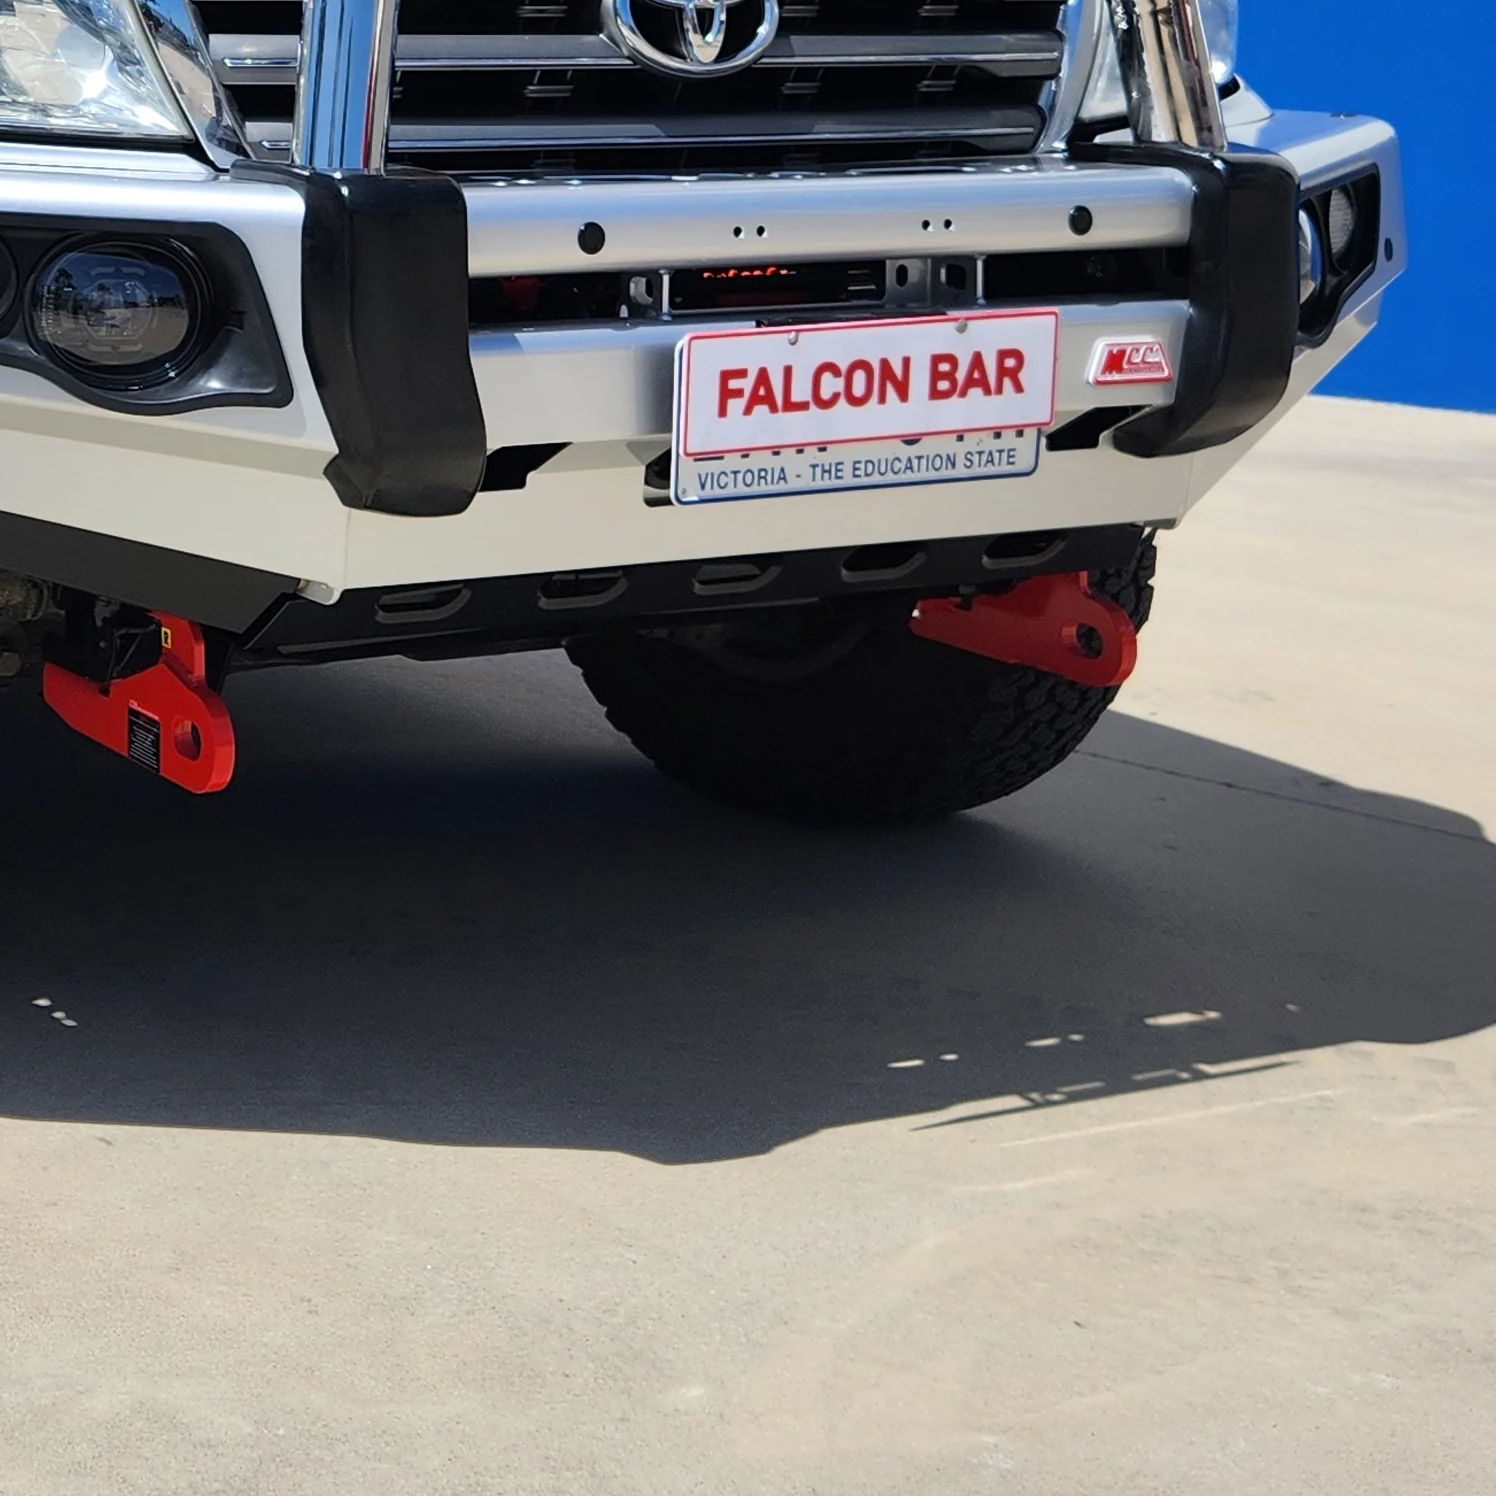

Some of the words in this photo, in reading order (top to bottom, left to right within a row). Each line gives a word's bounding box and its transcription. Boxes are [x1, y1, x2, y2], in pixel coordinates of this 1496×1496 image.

[717, 355, 912, 419] FALCON
[928, 347, 1026, 401] BAR
[697, 466, 788, 491] VICTORIA
[808, 460, 845, 482] THE
[851, 453, 958, 479] EDUCATION
[962, 448, 1018, 468] STATE
